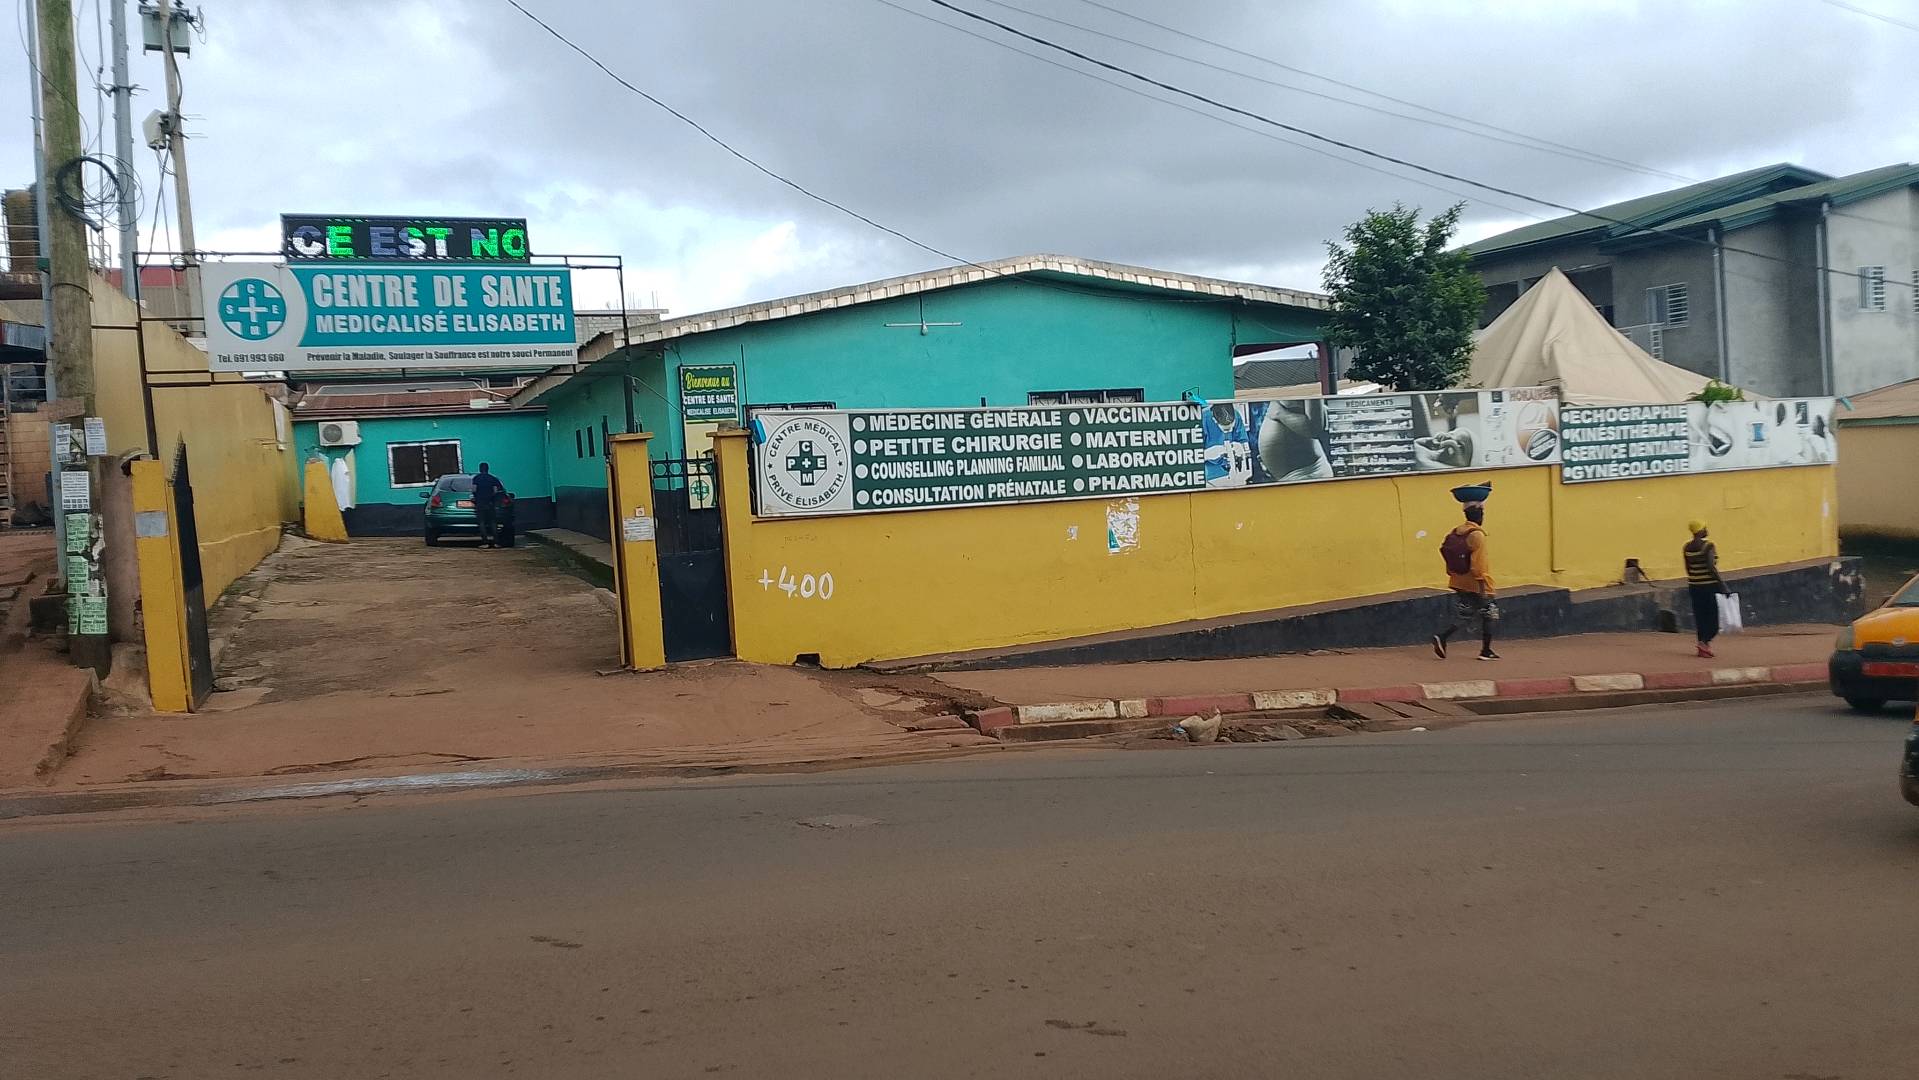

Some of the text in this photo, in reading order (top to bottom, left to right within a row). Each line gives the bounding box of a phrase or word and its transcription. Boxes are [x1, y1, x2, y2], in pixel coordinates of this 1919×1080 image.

[292, 225, 354, 256] CE
[369, 226, 453, 257] EST
[312, 274, 564, 308] CENTRE DE SANTE
[316, 310, 566, 333] MEDICALISÉ ELISABETH
[343, 352, 351, 361] la
[388, 351, 424, 361] Soulager
[425, 351, 433, 360] la
[434, 350, 477, 359] Souffrance
[478, 350, 490, 359] est
[491, 350, 510, 359] notre
[511, 349, 532, 358] souci
[534, 348, 573, 357] Permanent
[685, 372, 730, 390] Bienvenue au
[683, 394, 735, 405] CENTRE DE SANTE
[712, 407, 736, 415] ELISABETH
[870, 409, 1062, 431] MÉDECINE GÉNÉRALE
[1083, 405, 1202, 424] VACCINATION
[1569, 405, 1688, 424] ECHOGRAPHIE
[769, 421, 842, 458] CENTRE MÉDICAL
[1085, 425, 1204, 449] MATERNITÉ
[1569, 421, 1688, 442] KINÉSITHÉRAPIE
[801, 442, 811, 452] C
[870, 433, 1063, 456] PETITE CHIRURGIE
[1570, 443, 1627, 461] SERVICE
[787, 458, 826, 469] P E
[871, 455, 1066, 480] COUNSELLING PLANNING FAMILIAL
[1086, 448, 1205, 470] LABORATOIRE
[1571, 459, 1689, 480] GYNÉCOLOGIE
[802, 473, 813, 483] M
[1088, 470, 1206, 491] PHARMACIE
[769, 473, 844, 506] PRIVÉ ÉLISABETH
[872, 478, 1066, 506] CONSULTATION PRÉNATALE
